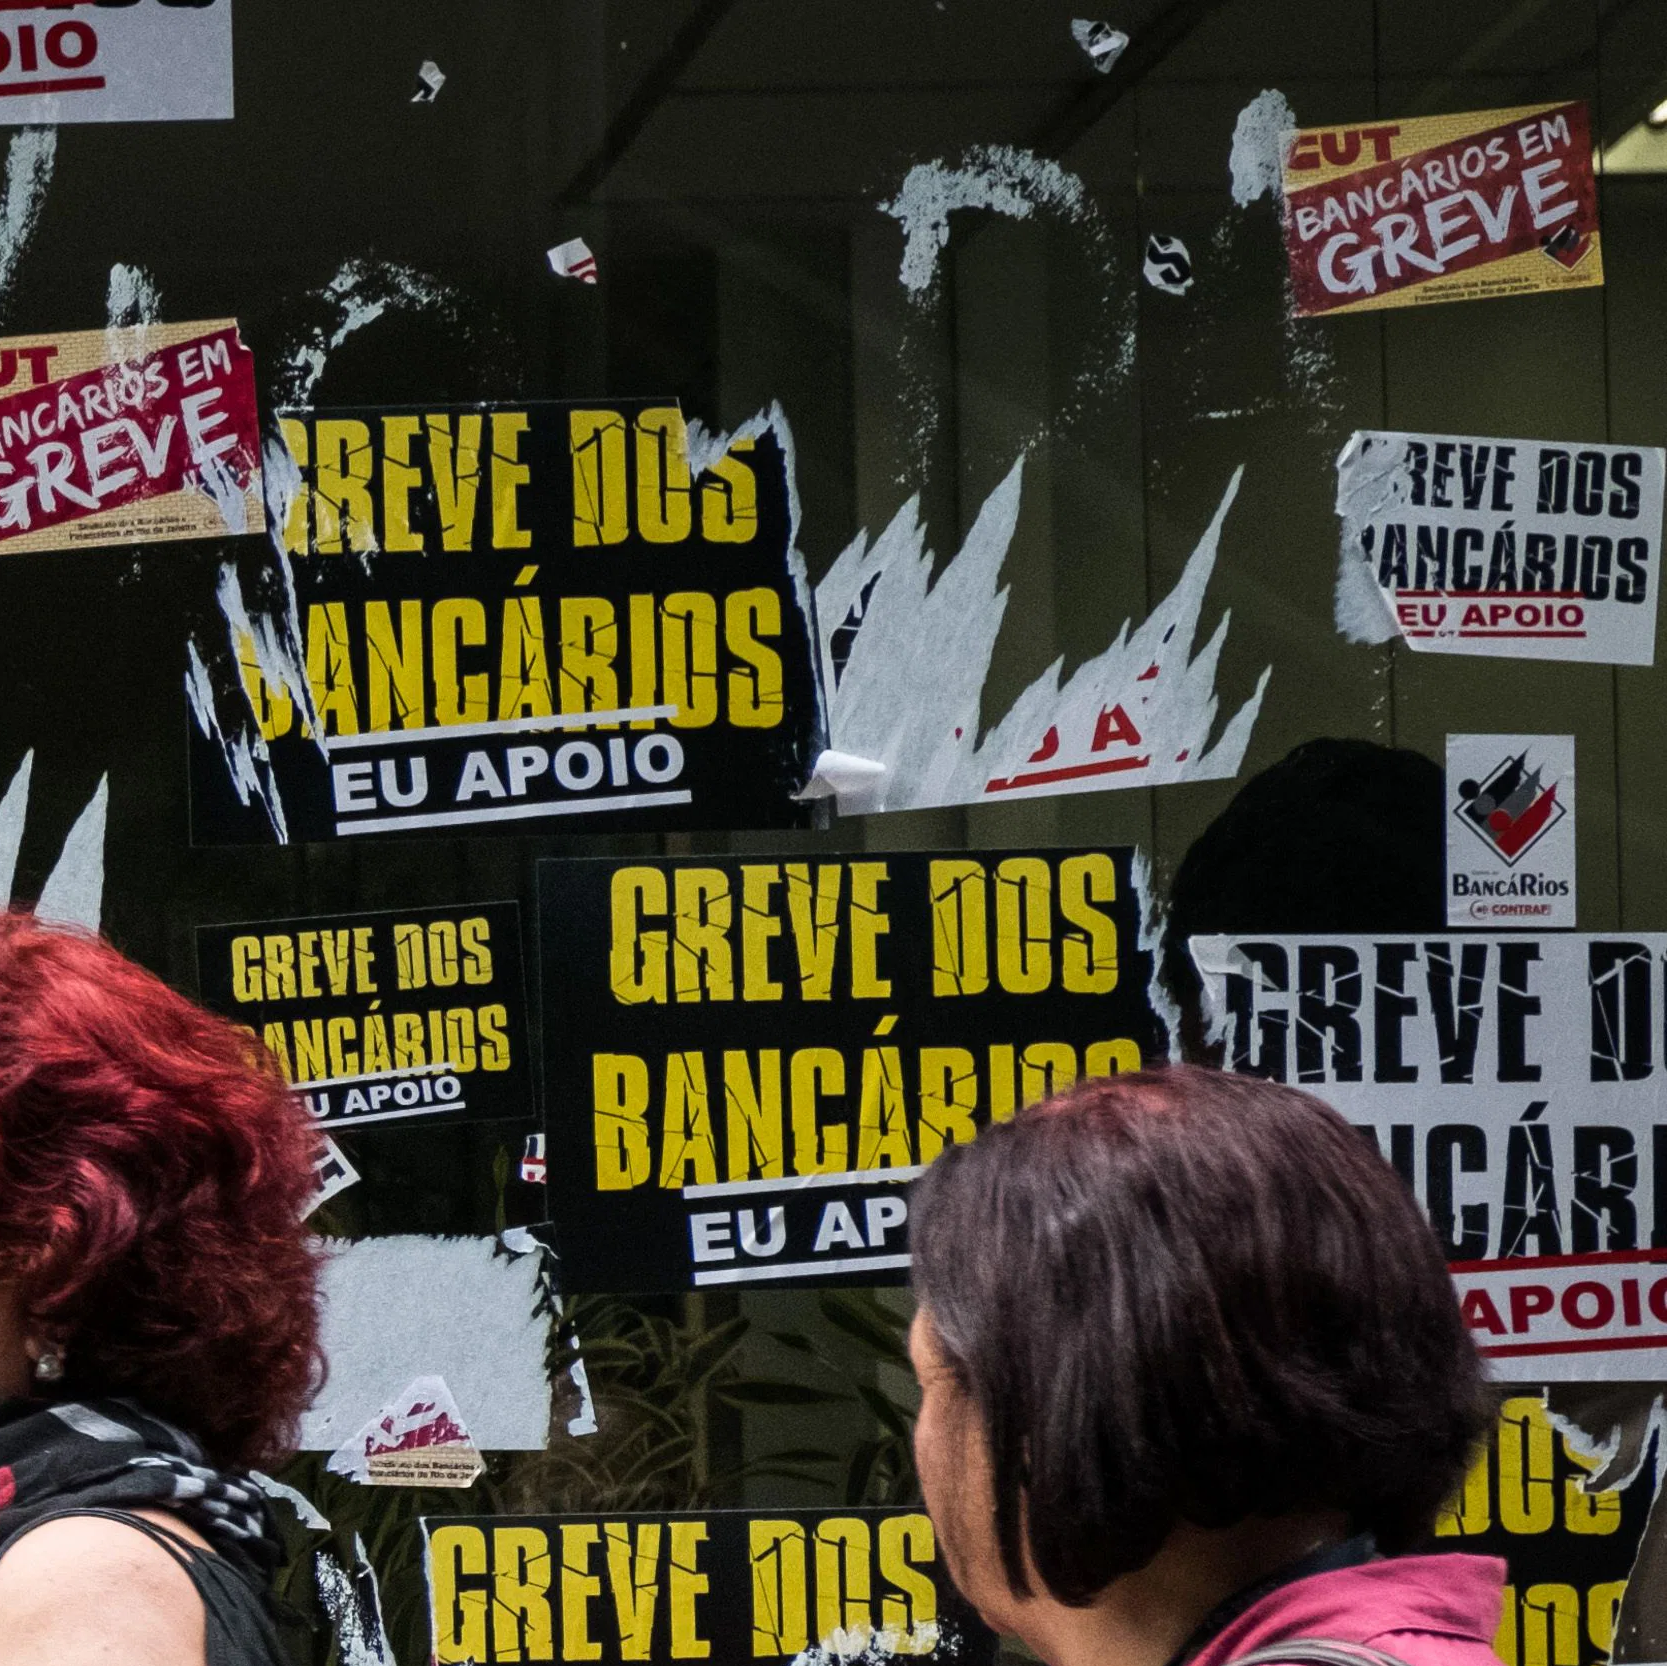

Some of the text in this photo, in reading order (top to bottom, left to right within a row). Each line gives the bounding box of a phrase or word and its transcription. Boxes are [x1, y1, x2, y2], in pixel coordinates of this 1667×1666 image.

[1287, 126, 1400, 171] CUT
[1295, 114, 1571, 242] BANCÁRIOS EM
[1318, 158, 1579, 294] GREVE
[178, 338, 232, 388] EM
[570, 406, 759, 546] DOS
[1397, 442, 1643, 520] REVE DOS
[1397, 603, 1584, 628] EU APOIO
[334, 734, 685, 812] EU APOIO
[231, 917, 493, 1003] GREVE DOS
[609, 852, 1119, 1005] GREVE DOS
[1225, 941, 1544, 1084] GREVE
[344, 1076, 461, 1114] APOIO
[689, 1204, 786, 1263] EU
[430, 1513, 939, 1664] GREVE DOS
